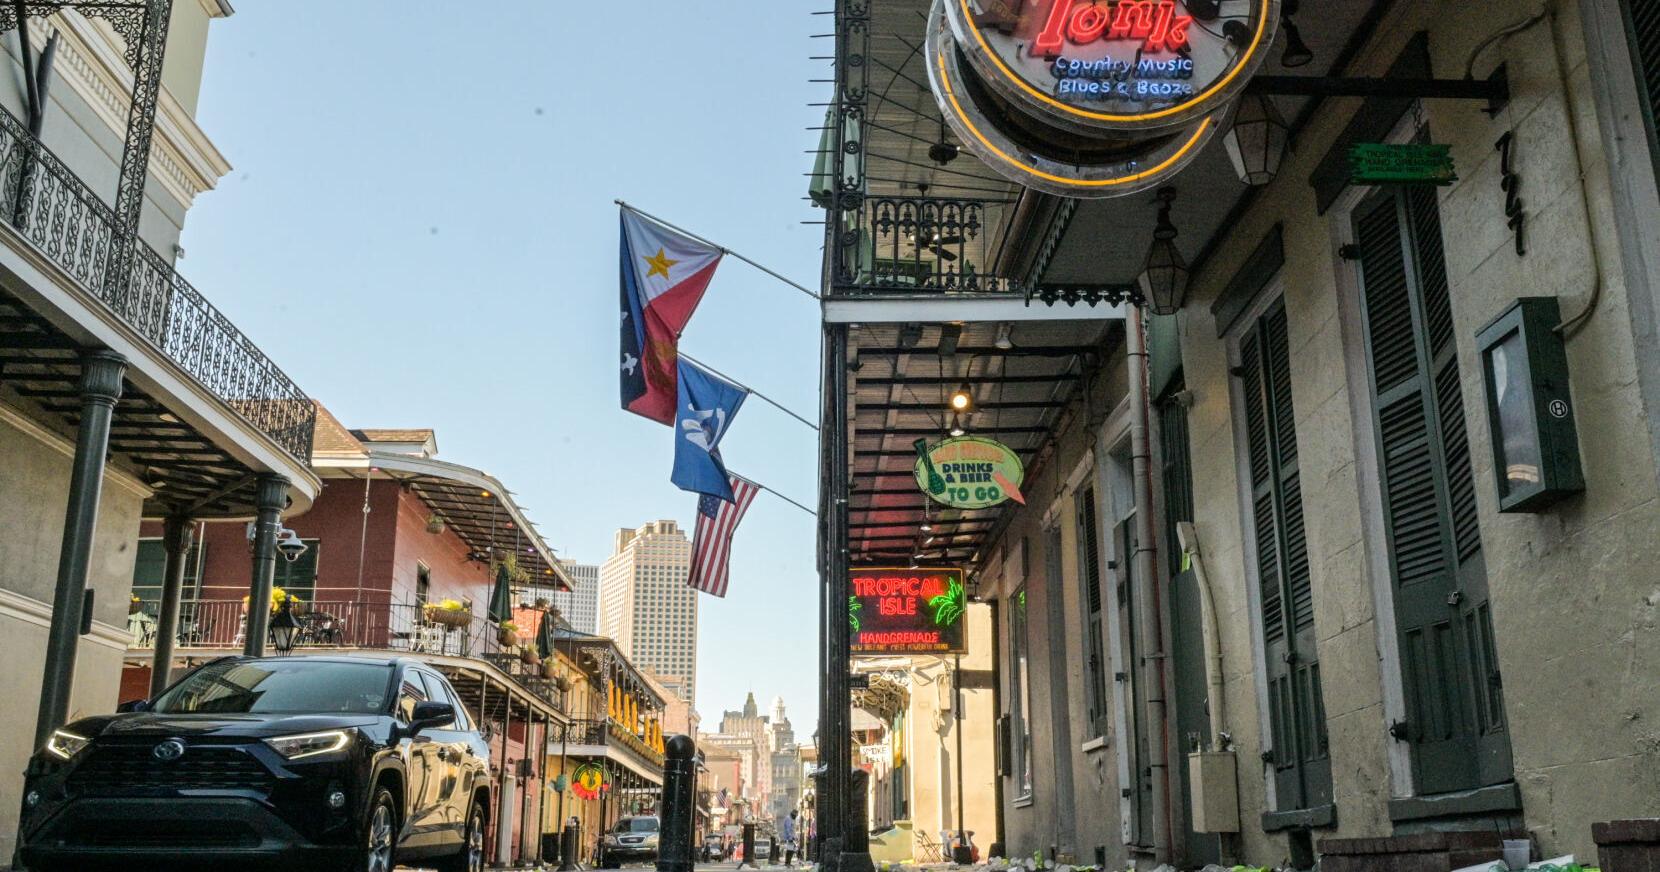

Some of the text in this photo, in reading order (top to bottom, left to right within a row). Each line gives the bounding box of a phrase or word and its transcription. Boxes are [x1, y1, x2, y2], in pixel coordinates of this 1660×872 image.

[1056, 55, 1193, 73] Country Music
[1060, 79, 1110, 93] Blues
[942, 463, 993, 473] DRINKS
[945, 473, 992, 483] & BEER
[948, 486, 1000, 502] TO GO
[853, 577, 944, 596] TROPICAL
[880, 597, 916, 615] ISLE
[860, 631, 940, 644] HANDGRENADE
